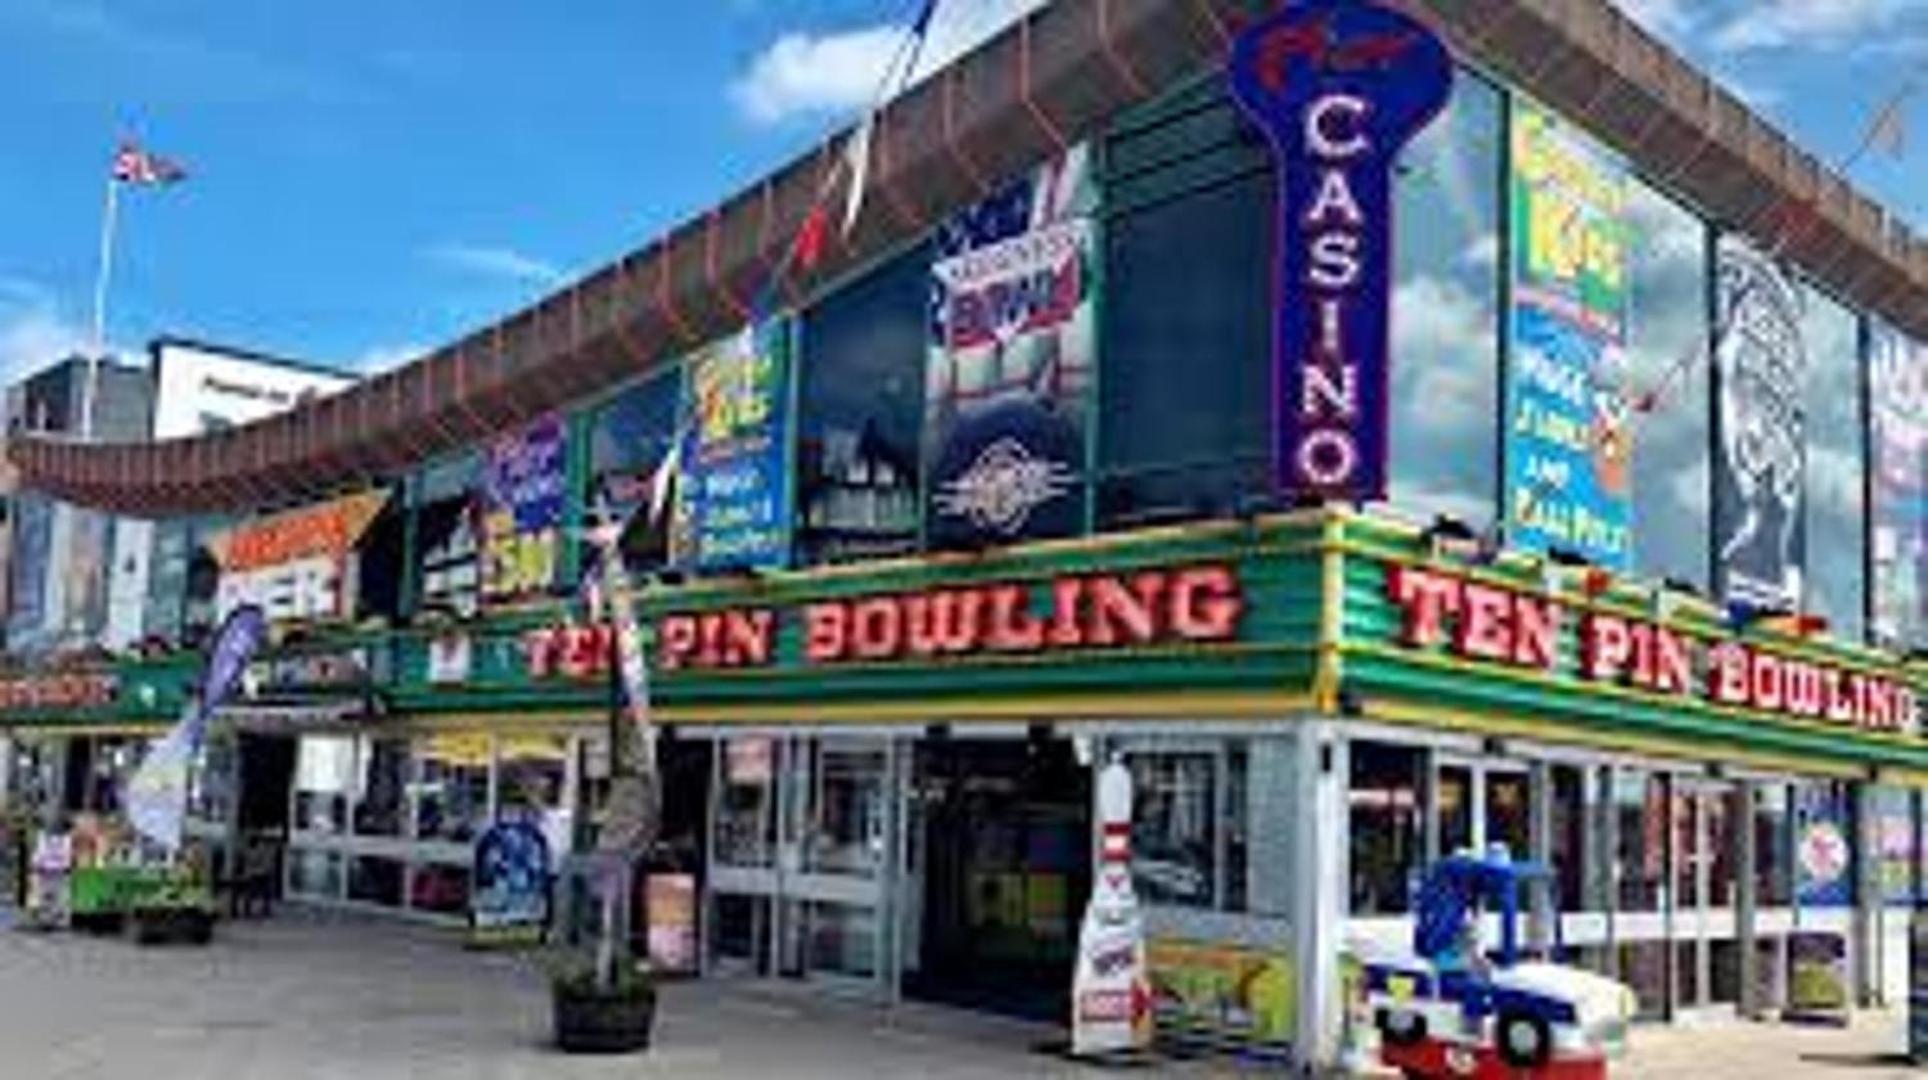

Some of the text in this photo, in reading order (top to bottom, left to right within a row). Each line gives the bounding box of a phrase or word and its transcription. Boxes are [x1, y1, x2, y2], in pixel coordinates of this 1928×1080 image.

[1299, 95, 1370, 484] CASINO
[661, 607, 772, 669] PIN
[807, 562, 1241, 662] BOWLING
[1389, 564, 1921, 735] TEN PIN BOWLING
